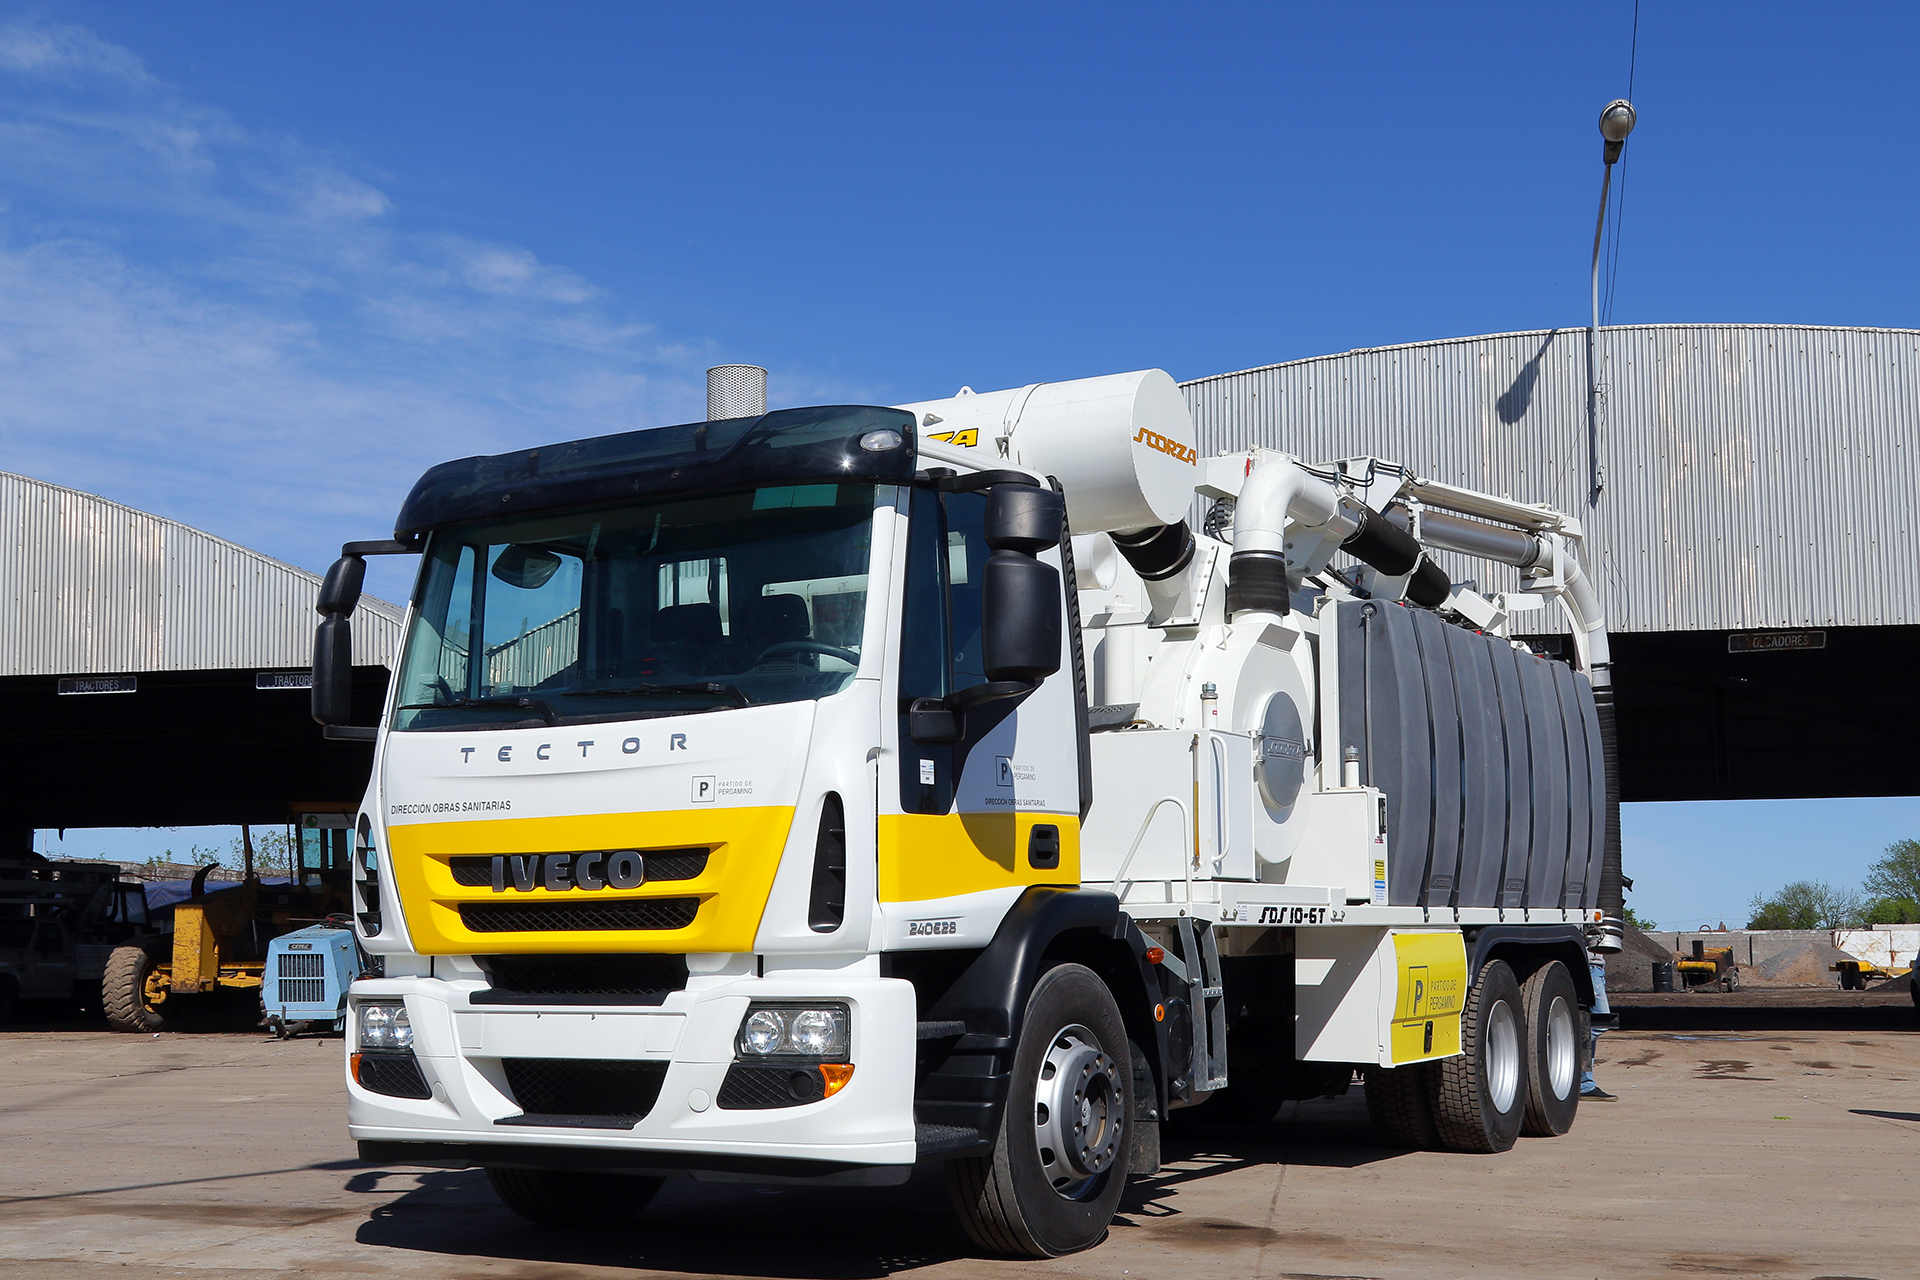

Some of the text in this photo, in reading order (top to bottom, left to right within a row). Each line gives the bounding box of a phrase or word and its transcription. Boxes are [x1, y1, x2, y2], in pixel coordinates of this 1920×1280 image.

[1133, 427, 1196, 467] SCORZA
[75, 679, 120, 691] TRACTORES
[460, 733, 688, 764] TECTOR
[1001, 762, 1008, 781] P
[1013, 772, 1036, 781] PERGAMINO
[699, 781, 709, 797] P
[718, 787, 753, 795] PERGAMINO
[391, 800, 512, 815] DIRECCIÓN OBRAS SANITARIAS
[1008, 798, 1023, 806] OBRAS
[1023, 799, 1046, 807] SANITARIAS
[491, 850, 645, 893] IVECO
[909, 921, 957, 936] 240E28
[1430, 979, 1457, 991] PARTIDO DE
[1413, 979, 1424, 1016] P
[1430, 995, 1456, 1011] PERGAMINO
